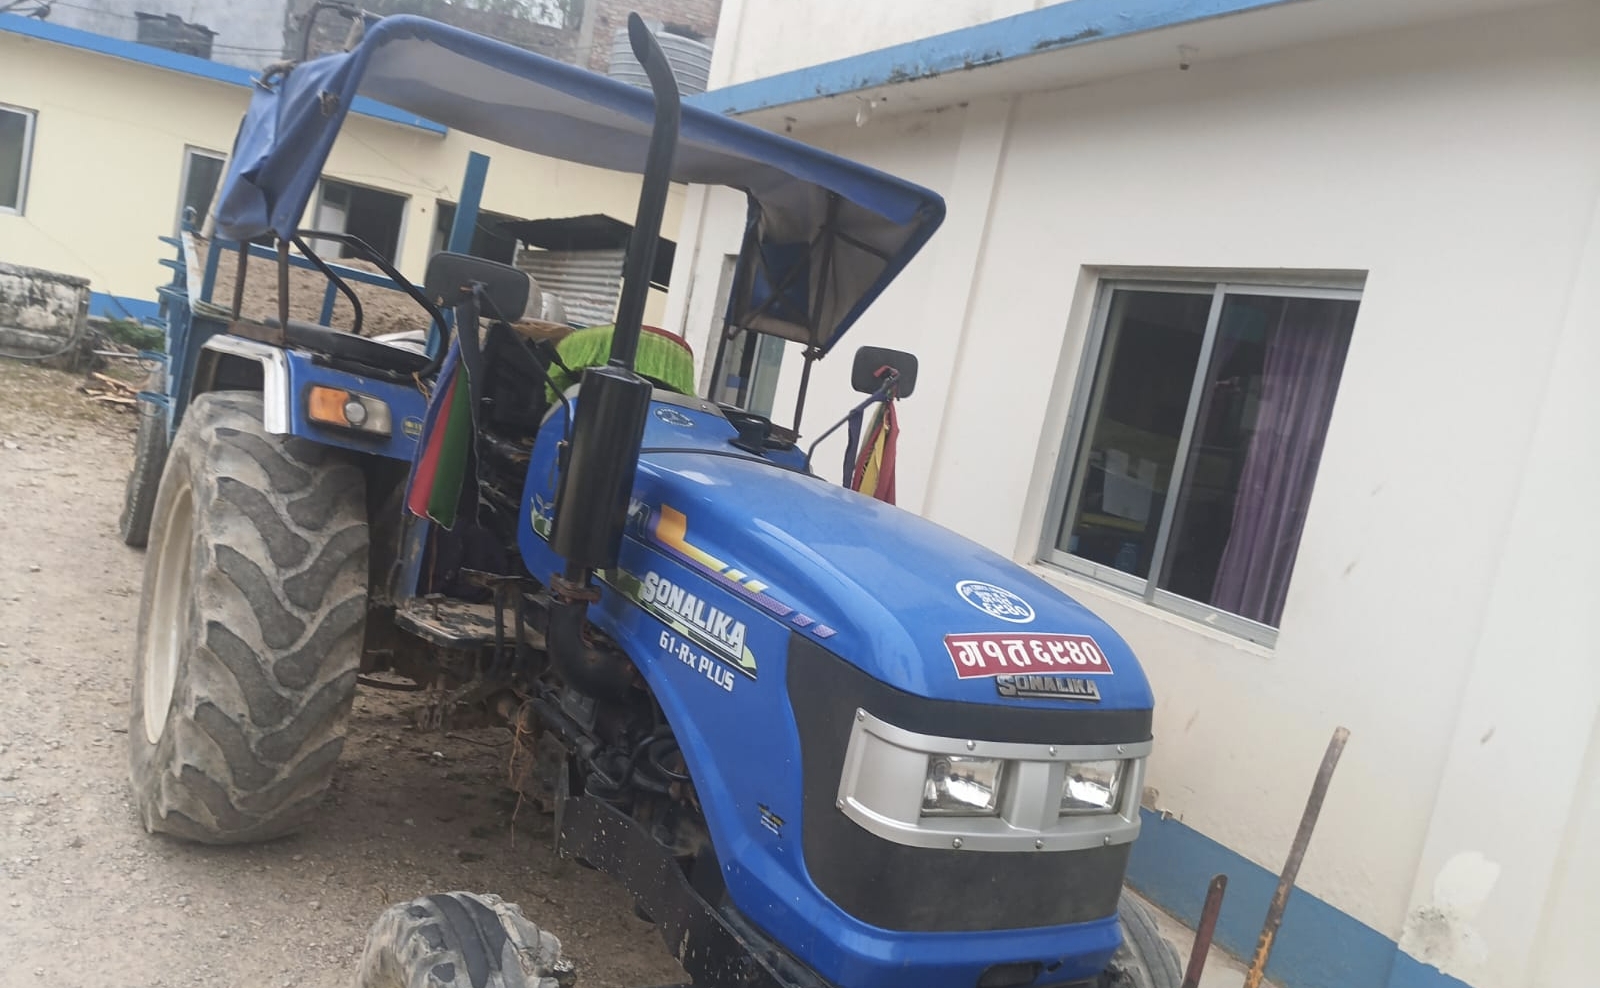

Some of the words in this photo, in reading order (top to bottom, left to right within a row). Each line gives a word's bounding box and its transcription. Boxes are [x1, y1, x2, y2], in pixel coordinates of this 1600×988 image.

[642, 571, 746, 655] SONALIKA
[659, 630, 695, 668] 61-Rx
[698, 656, 735, 692] PLUS
[997, 675, 1101, 700] SONALIKA
